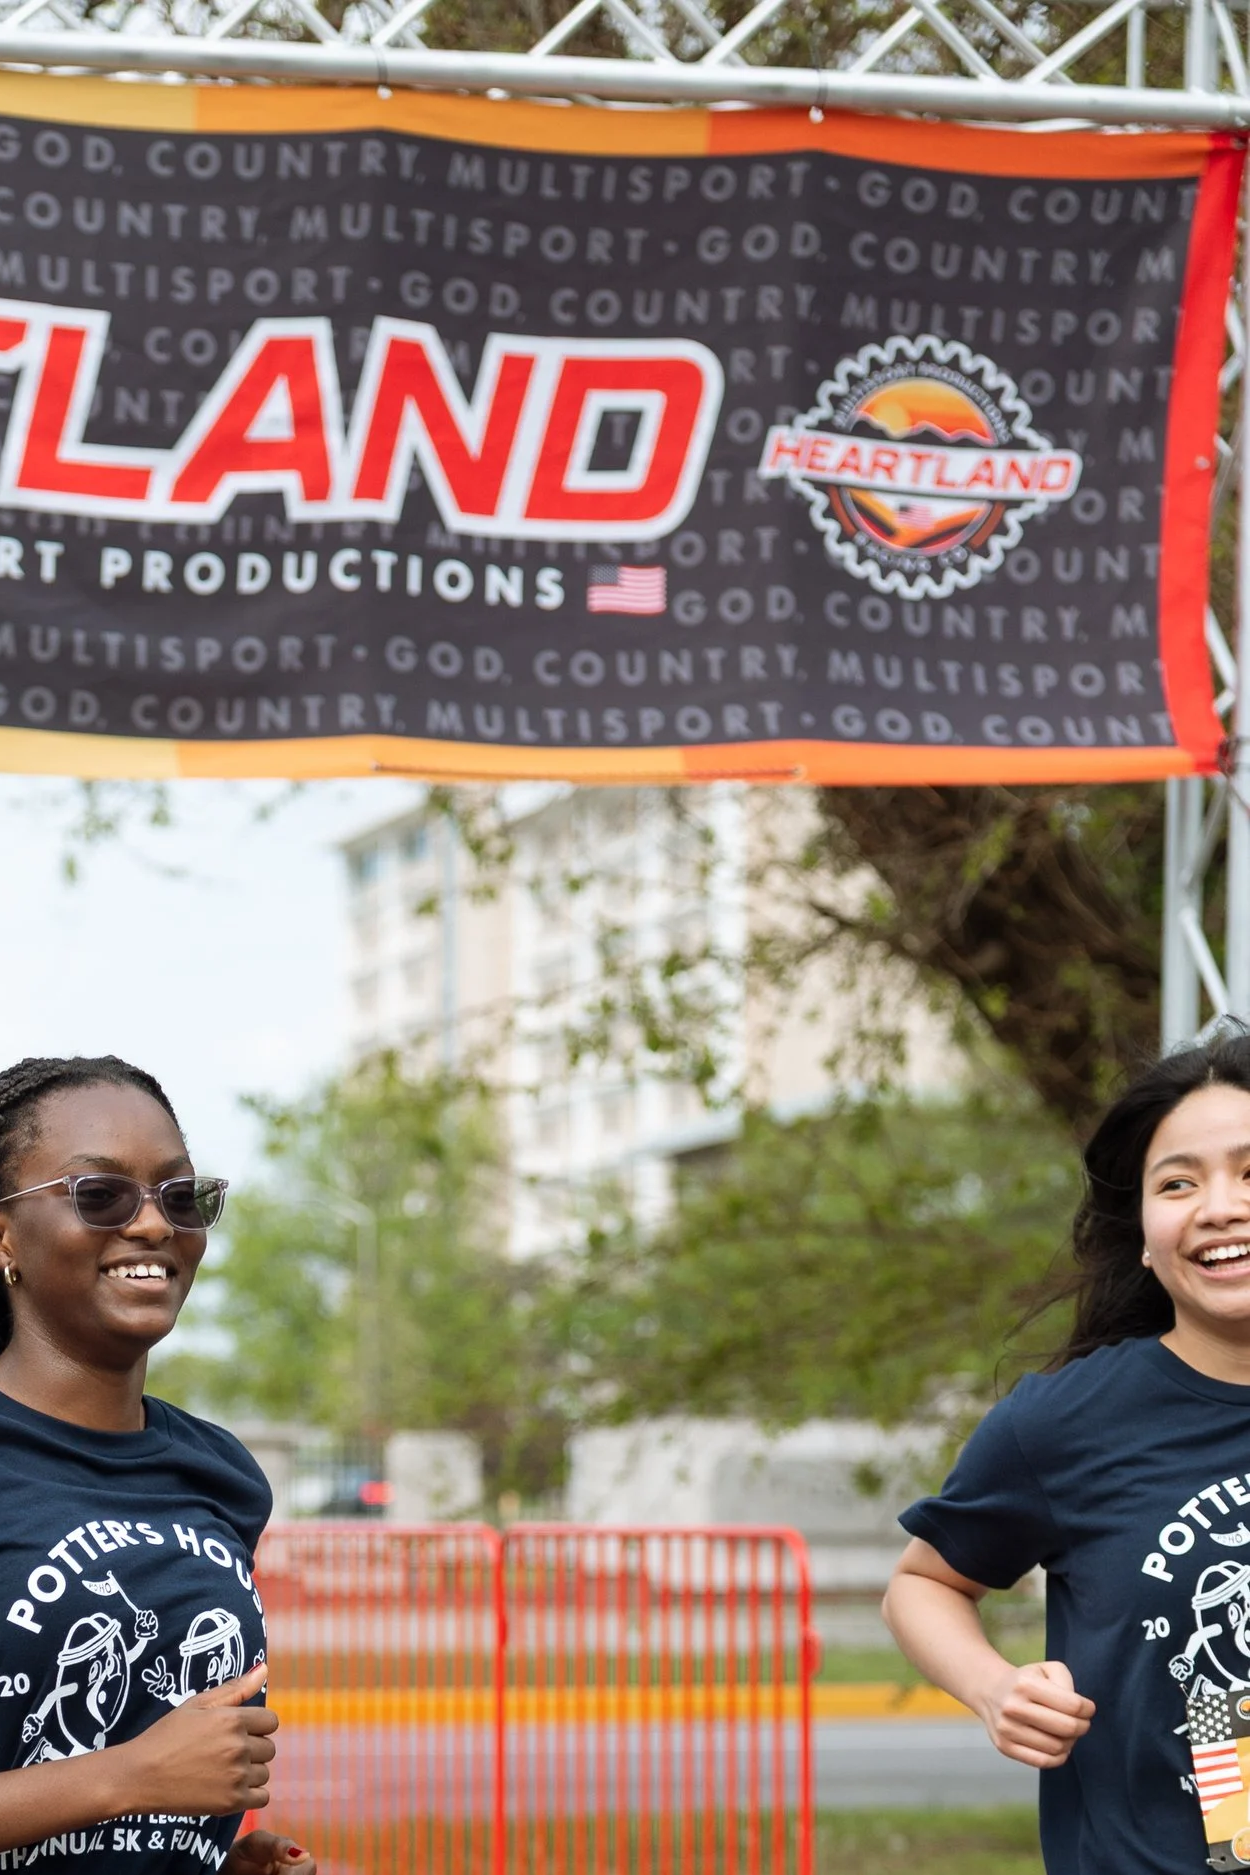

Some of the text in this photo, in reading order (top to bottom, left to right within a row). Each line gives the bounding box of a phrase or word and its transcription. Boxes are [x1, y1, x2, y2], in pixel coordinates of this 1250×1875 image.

[446, 151, 812, 204] MULTISPORT
[288, 201, 648, 266] MULTISPORT
[840, 291, 1184, 348] MULTISPOR
[766, 432, 1078, 494] HEARTLAND
[102, 546, 566, 610] PRODUCTIONS
[826, 647, 1165, 699] MULTISPOR
[426, 699, 785, 742] MULTISPORT
[1141, 1473, 1250, 1583] POTTE
[6, 1520, 165, 1635] POTTER'S
[1141, 1616, 1171, 1641] 20
[112, 1828, 142, 1852] 5K
[147, 1830, 166, 1850] &
